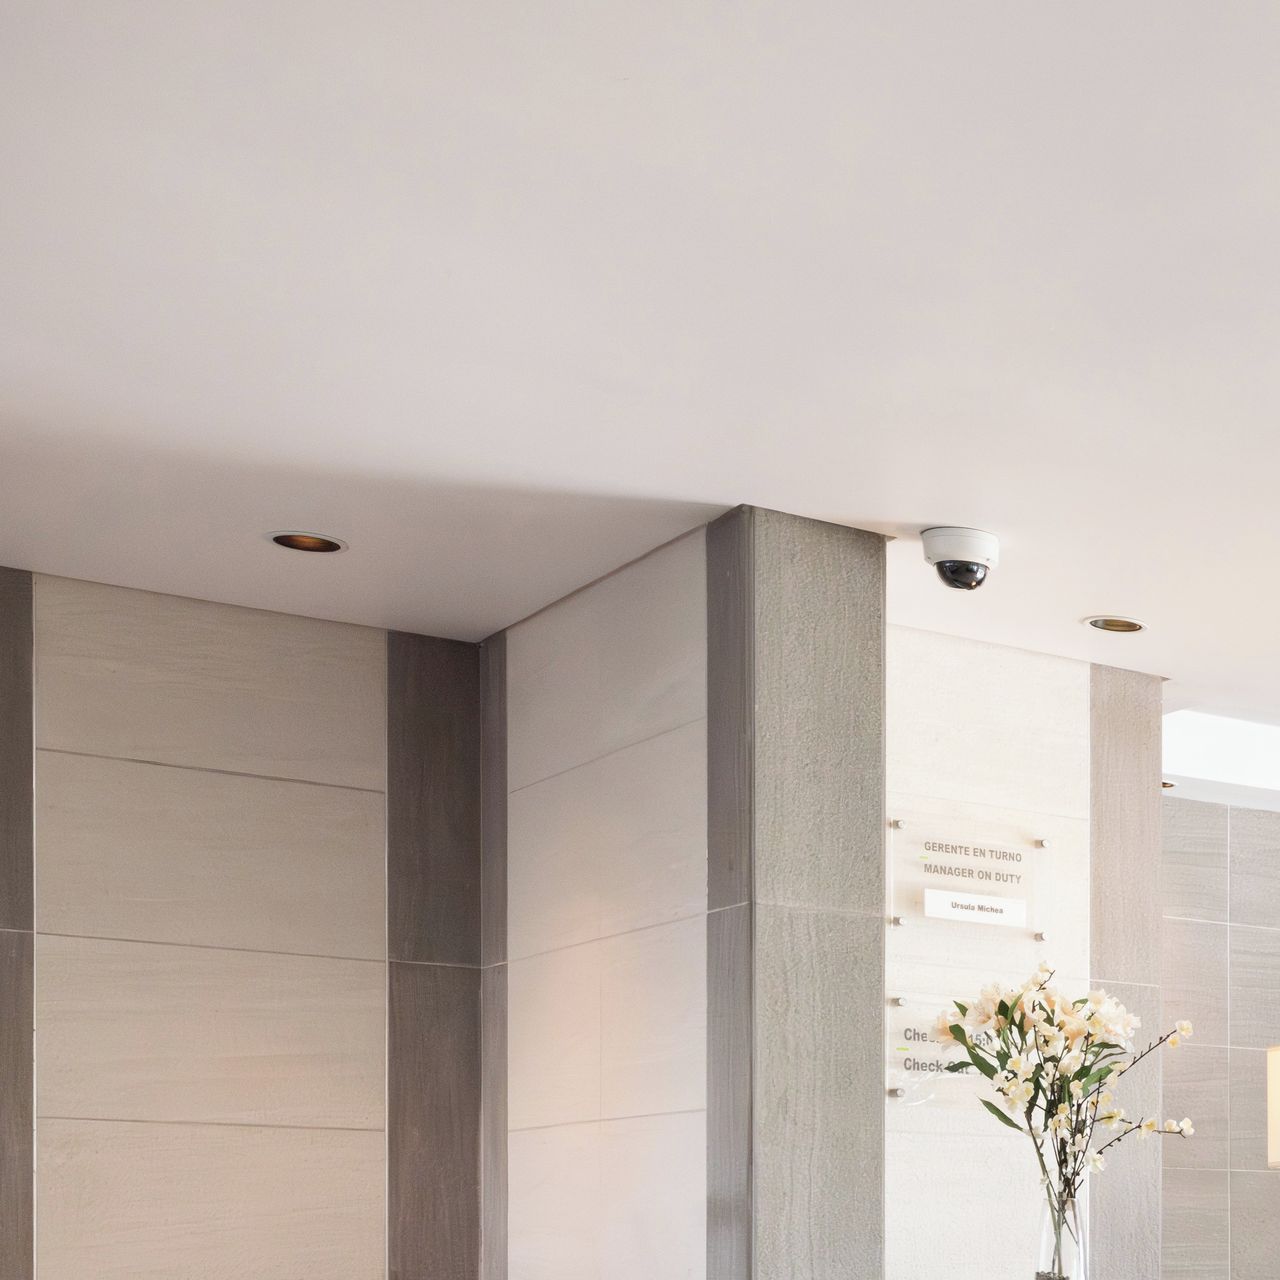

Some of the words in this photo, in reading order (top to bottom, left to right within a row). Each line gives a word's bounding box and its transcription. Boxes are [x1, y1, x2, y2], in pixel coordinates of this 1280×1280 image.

[924, 841, 970, 857] GERENTE
[973, 847, 986, 858] EN
[989, 849, 1022, 863] TURNO
[923, 863, 974, 878] MANAGER
[977, 870, 992, 881] ON
[995, 872, 1022, 885] DUTY
[903, 1057, 943, 1073] Check
